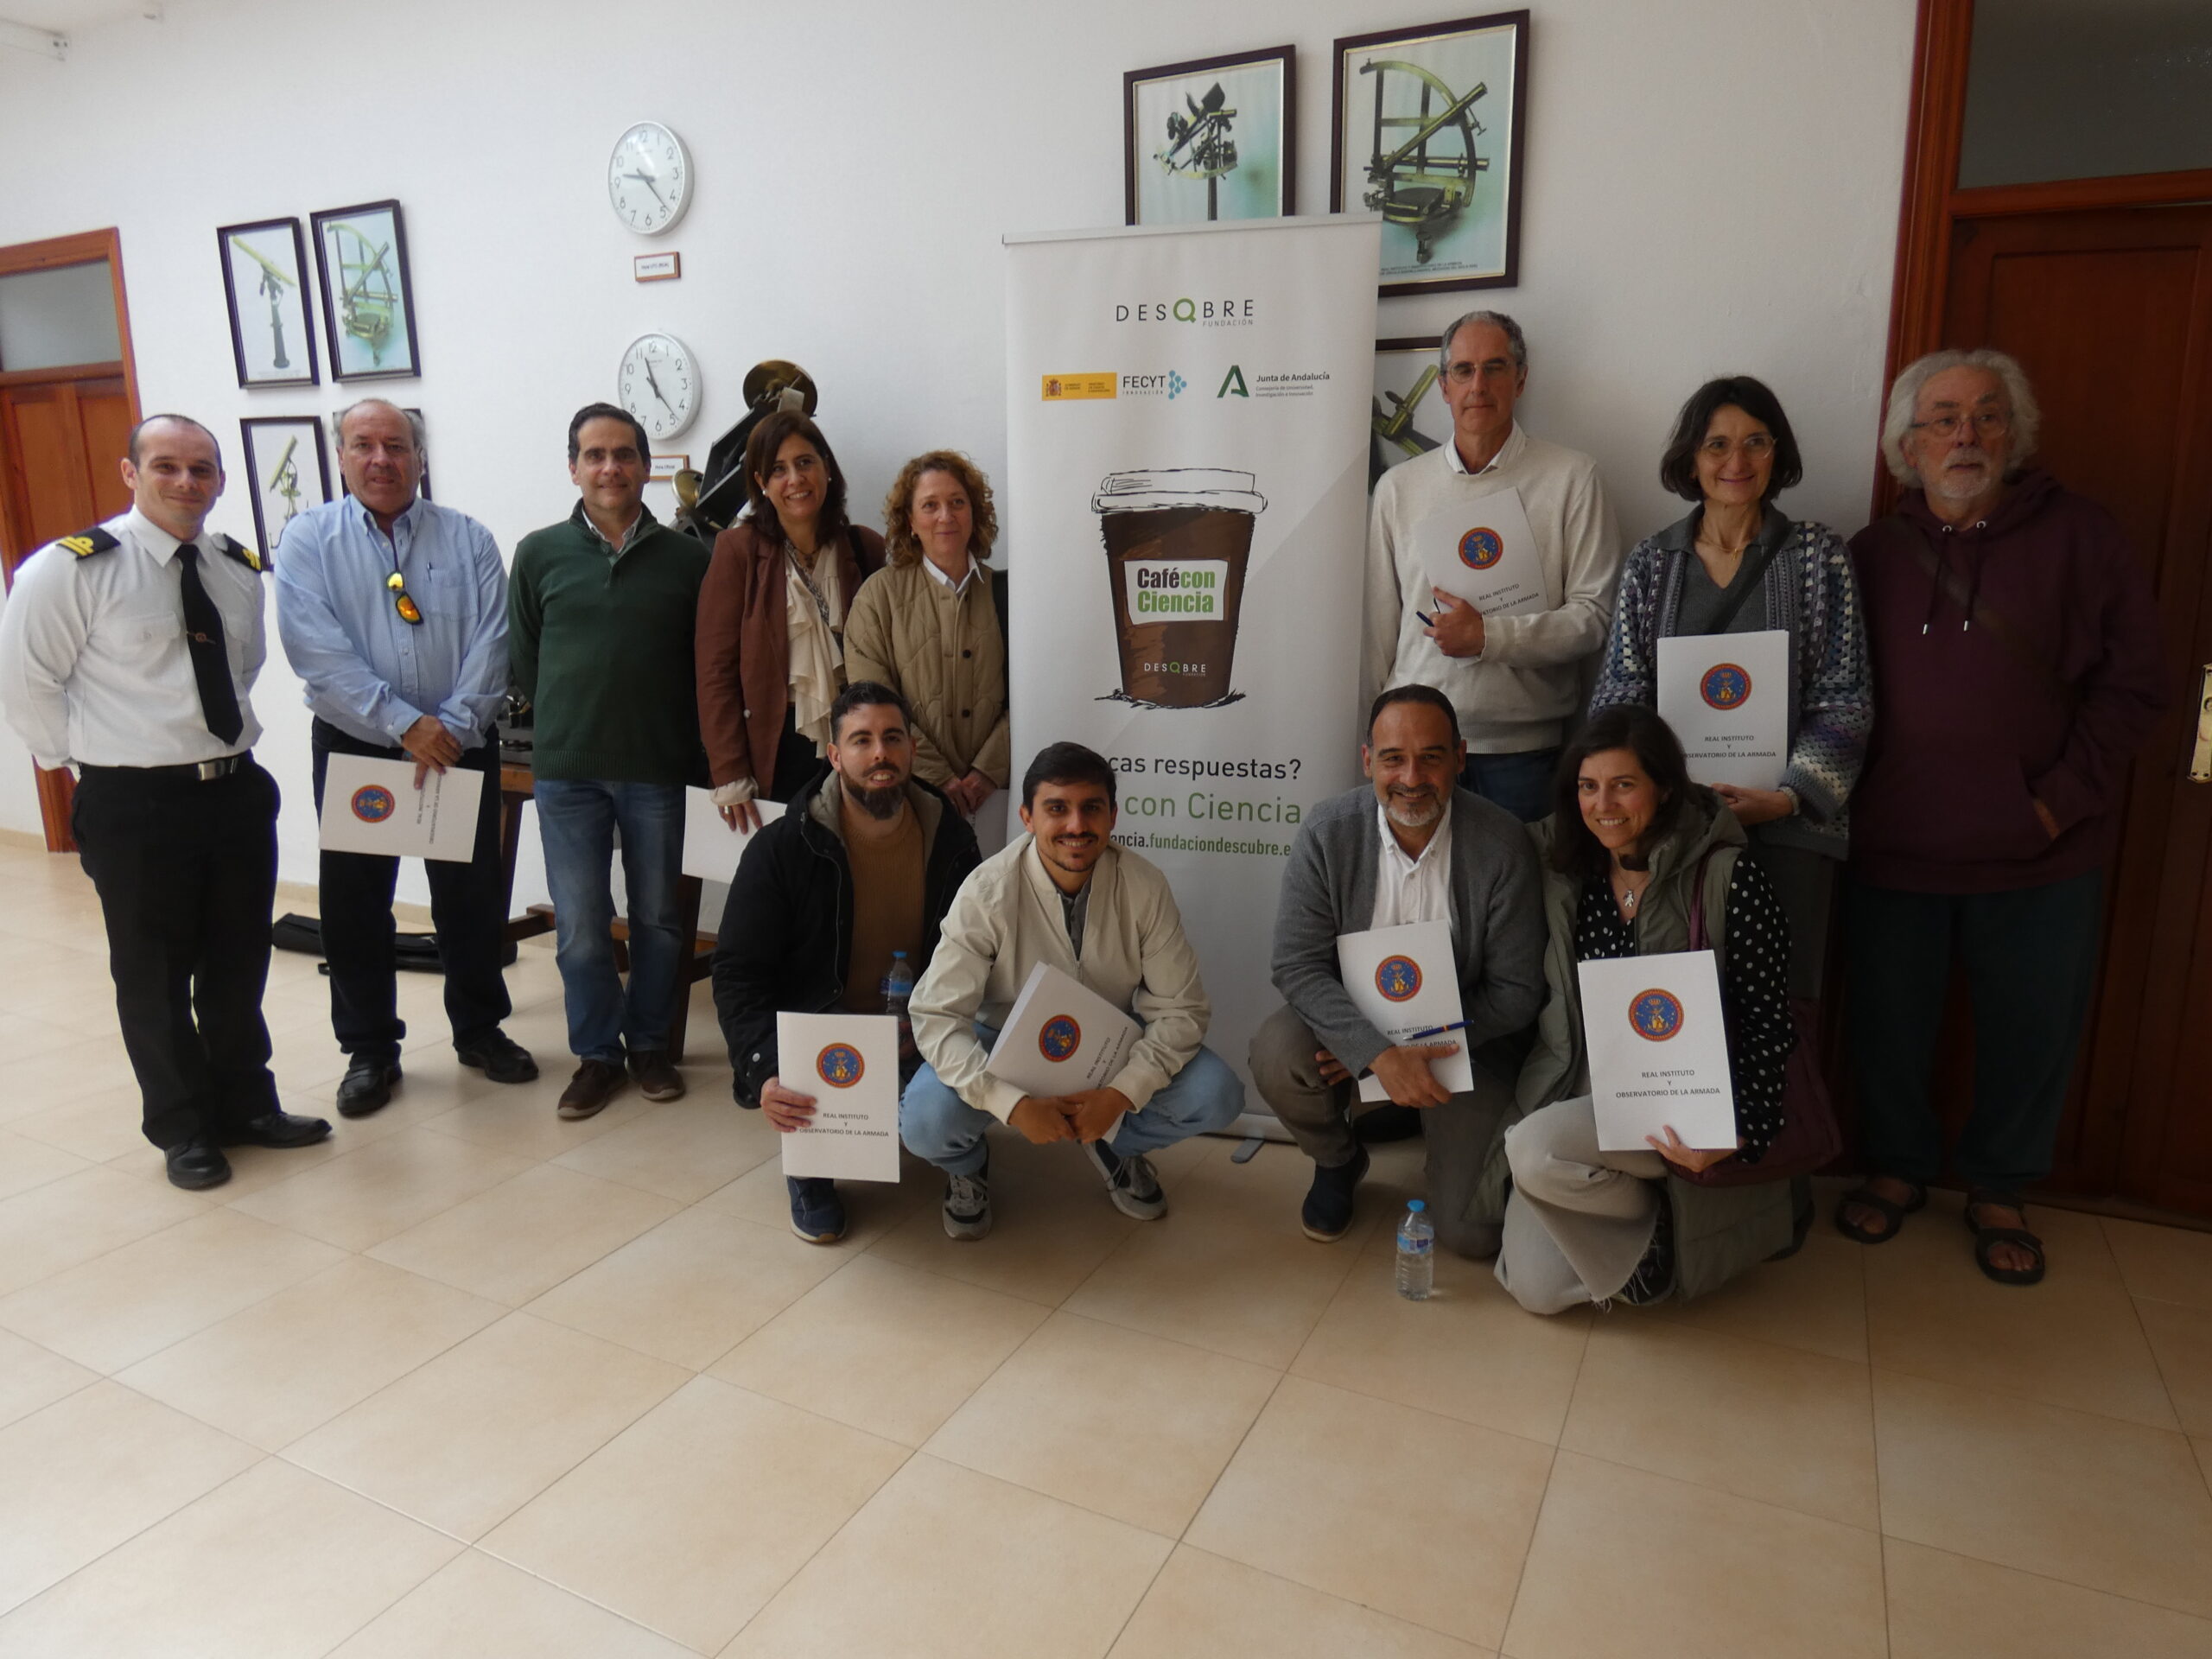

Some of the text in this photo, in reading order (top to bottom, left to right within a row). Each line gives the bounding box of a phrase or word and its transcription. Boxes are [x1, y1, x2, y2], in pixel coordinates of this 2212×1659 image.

[666, 147, 674, 160] 2
[673, 167, 679, 180] 3
[614, 176, 620, 189] 9
[670, 188, 676, 200] 4
[620, 197, 626, 209] 8
[631, 210, 637, 226] 7
[659, 207, 666, 219] 5
[645, 213, 652, 226] 6
[626, 363, 634, 375] 10
[675, 359, 683, 371] 2
[1122, 375, 1166, 388] FECYT
[1291, 371, 1330, 381] Andalucía
[624, 383, 632, 395] 9
[681, 378, 688, 390] 3
[630, 402, 636, 414] 8
[678, 398, 685, 410] 4
[641, 416, 646, 427] 7
[655, 419, 662, 432] 6
[670, 414, 676, 426] 5
[1492, 583, 1520, 596] INSTITUTO
[1137, 590, 1214, 613] Ciencia
[1517, 593, 1539, 605] ARMADA
[1109, 756, 1301, 781] cas respuestas?
[1124, 791, 1301, 823] con Ciencia
[1110, 831, 1291, 856] ncia.fundaciondescubre.e
[1402, 1025, 1433, 1033] INSTITUTO
[1616, 1090, 1669, 1098] OBSERVATORIO
